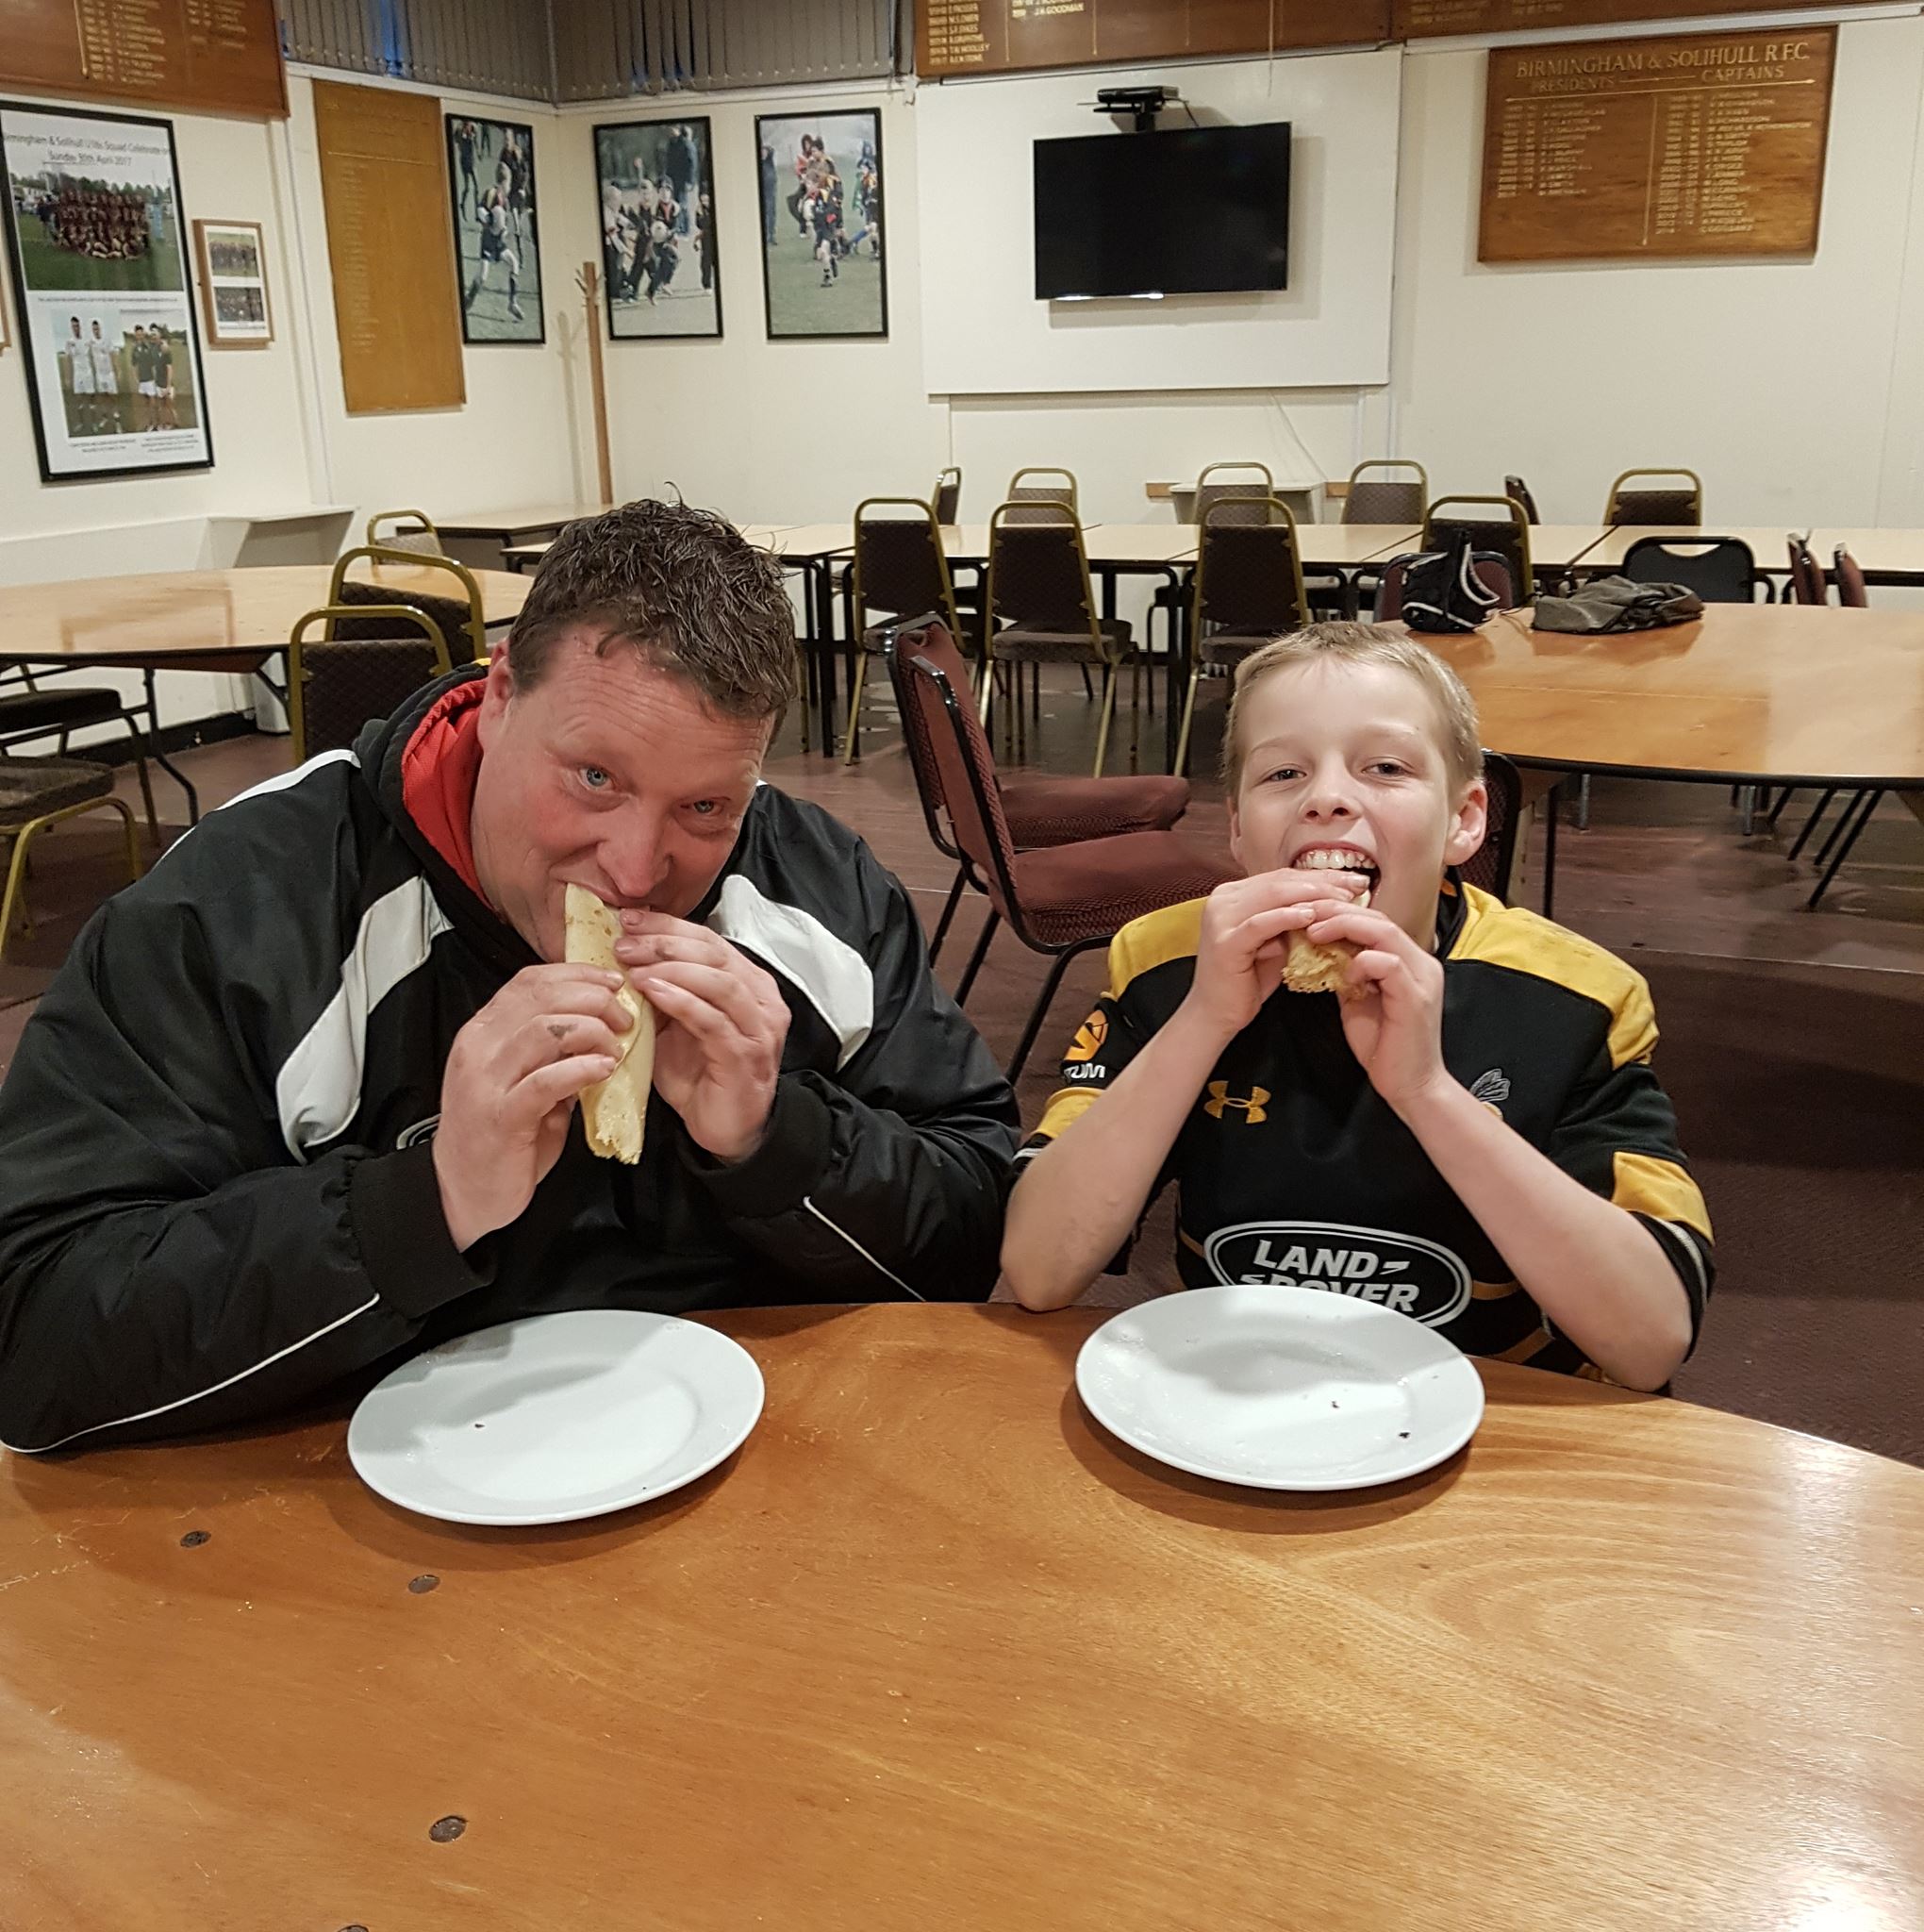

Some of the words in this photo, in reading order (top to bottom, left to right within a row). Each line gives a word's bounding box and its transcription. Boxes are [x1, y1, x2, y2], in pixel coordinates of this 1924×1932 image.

[1516, 54, 1643, 77] BIRMINGHAM
[1648, 56, 1662, 69] &
[1667, 45, 1759, 68] SOLIHULL
[1701, 65, 1784, 82] CAPTAINS
[1252, 1239, 1380, 1279] LAND
